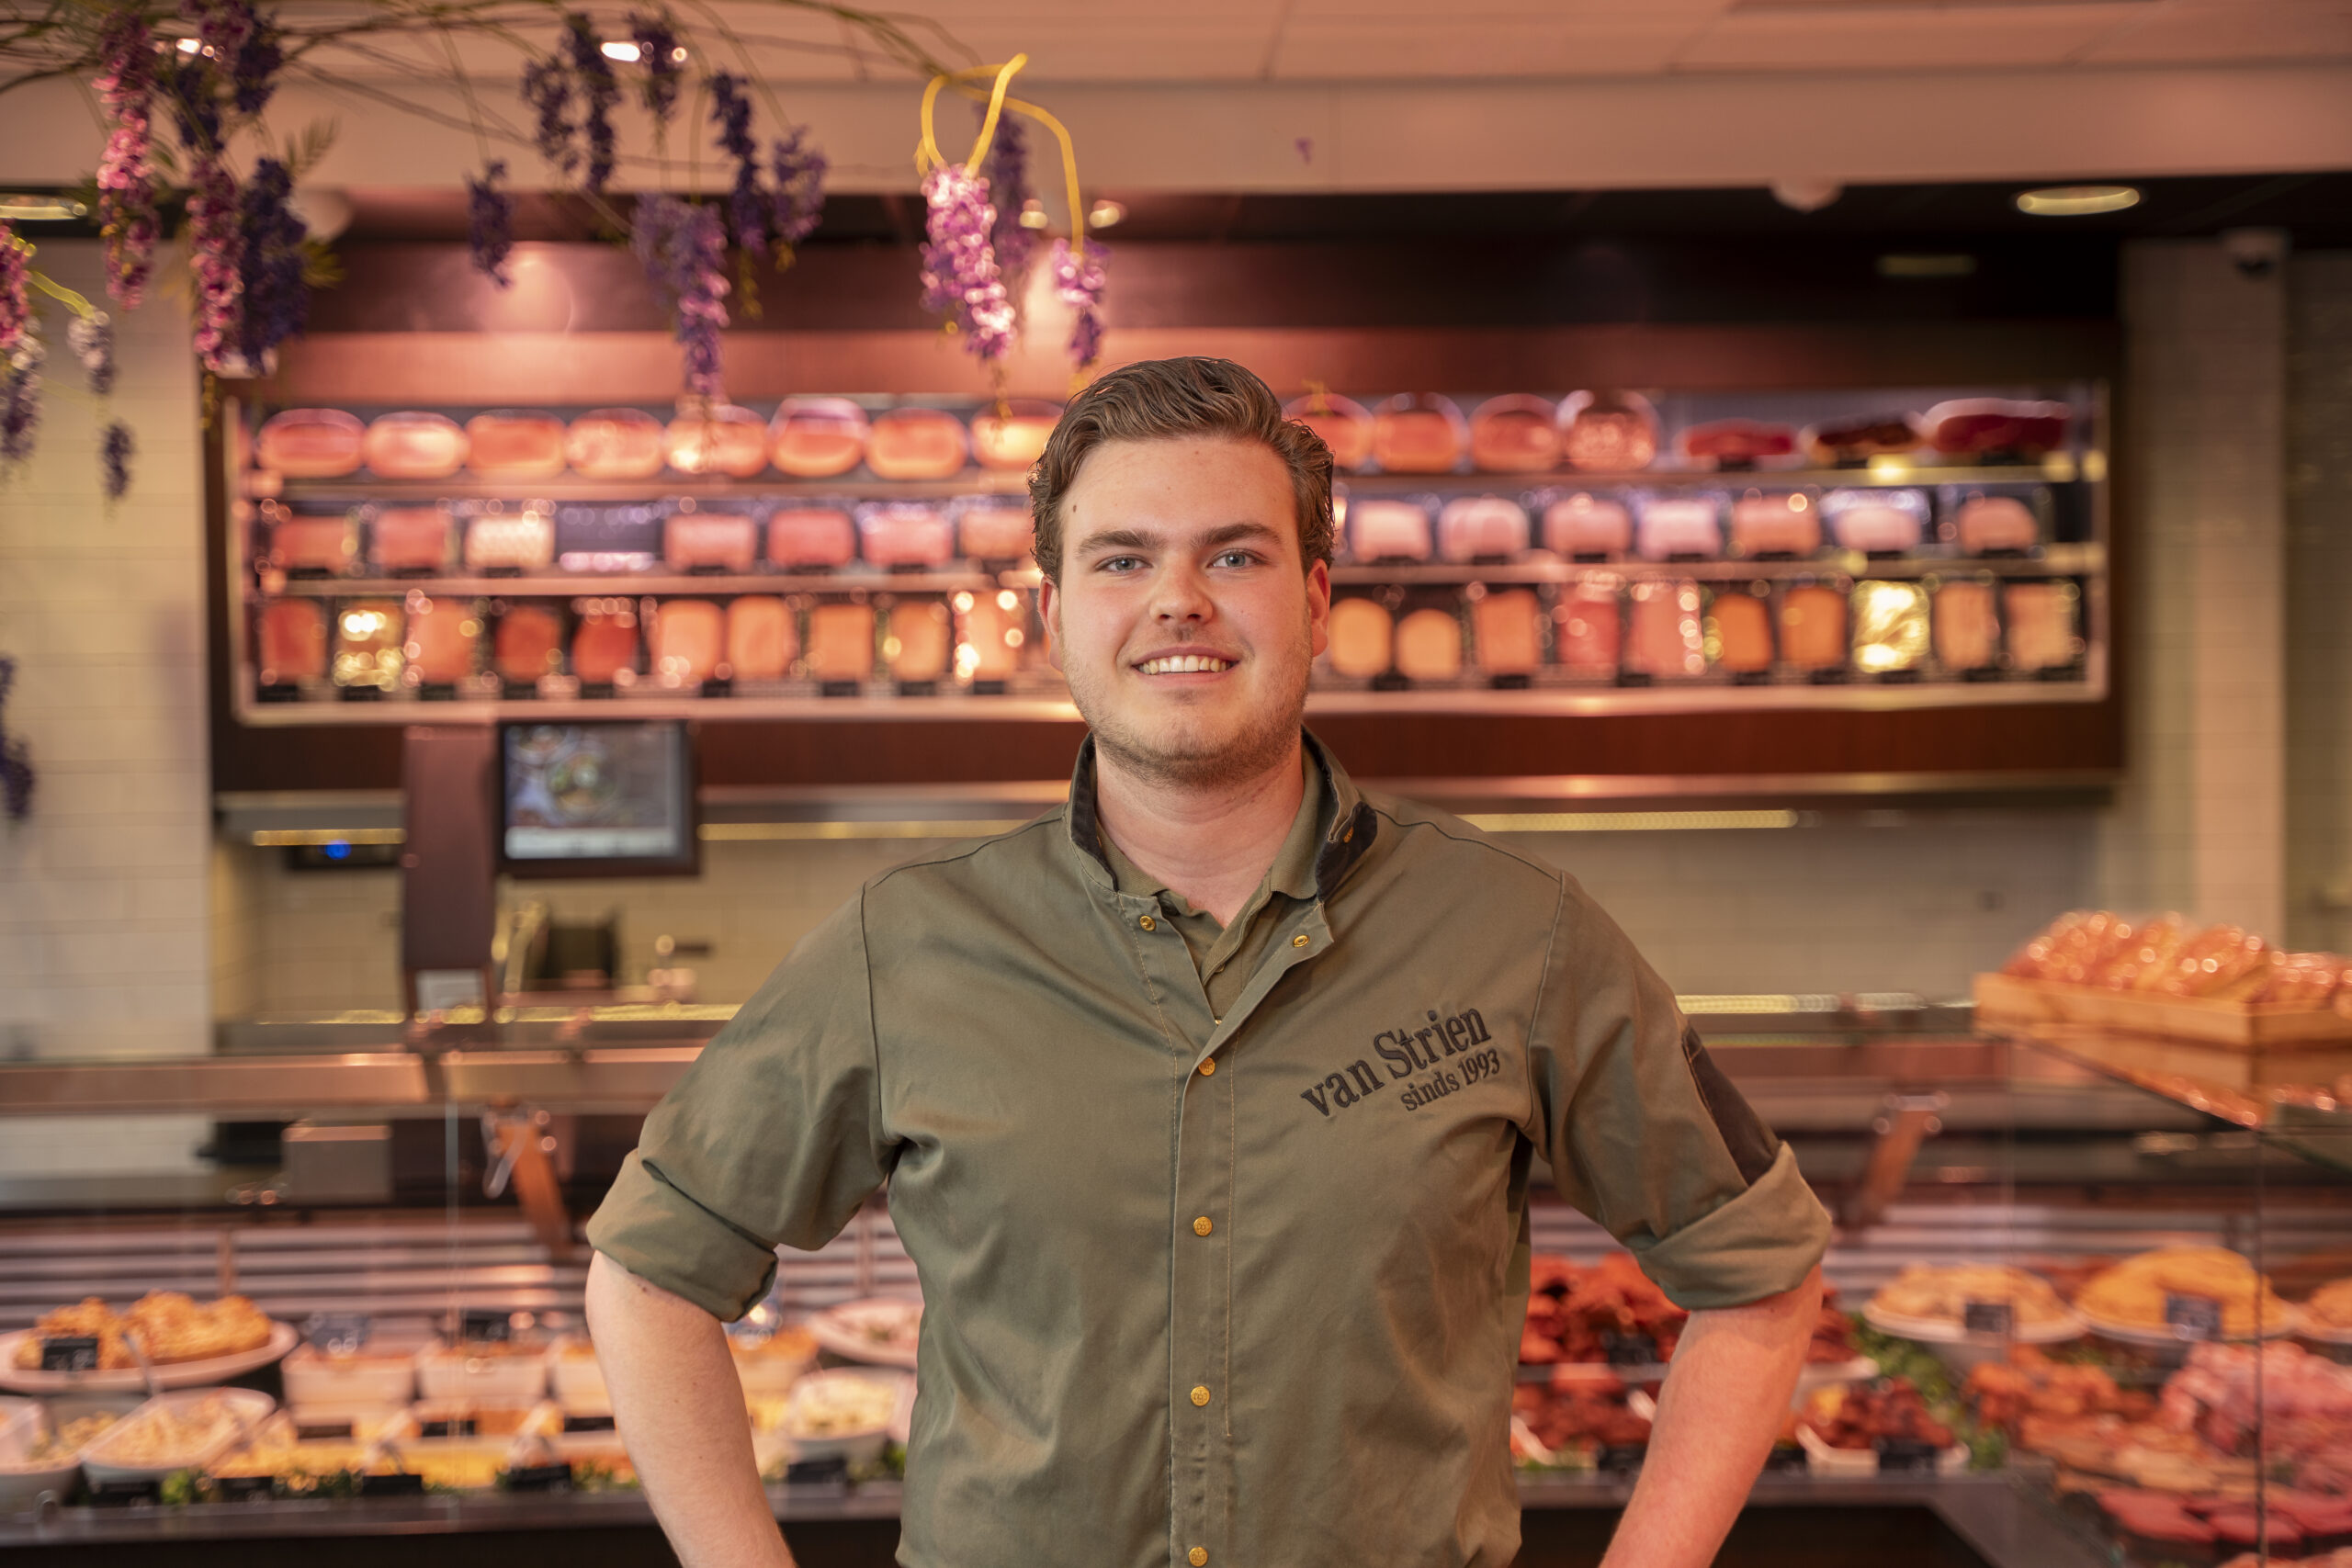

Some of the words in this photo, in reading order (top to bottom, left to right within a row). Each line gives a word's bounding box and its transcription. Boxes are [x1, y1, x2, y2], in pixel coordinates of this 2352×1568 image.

[1300, 1059, 1385, 1117] van
[1374, 1009, 1491, 1079] Strien
[1400, 1072, 1460, 1111] sinds
[1457, 1048, 1500, 1086] 1993
